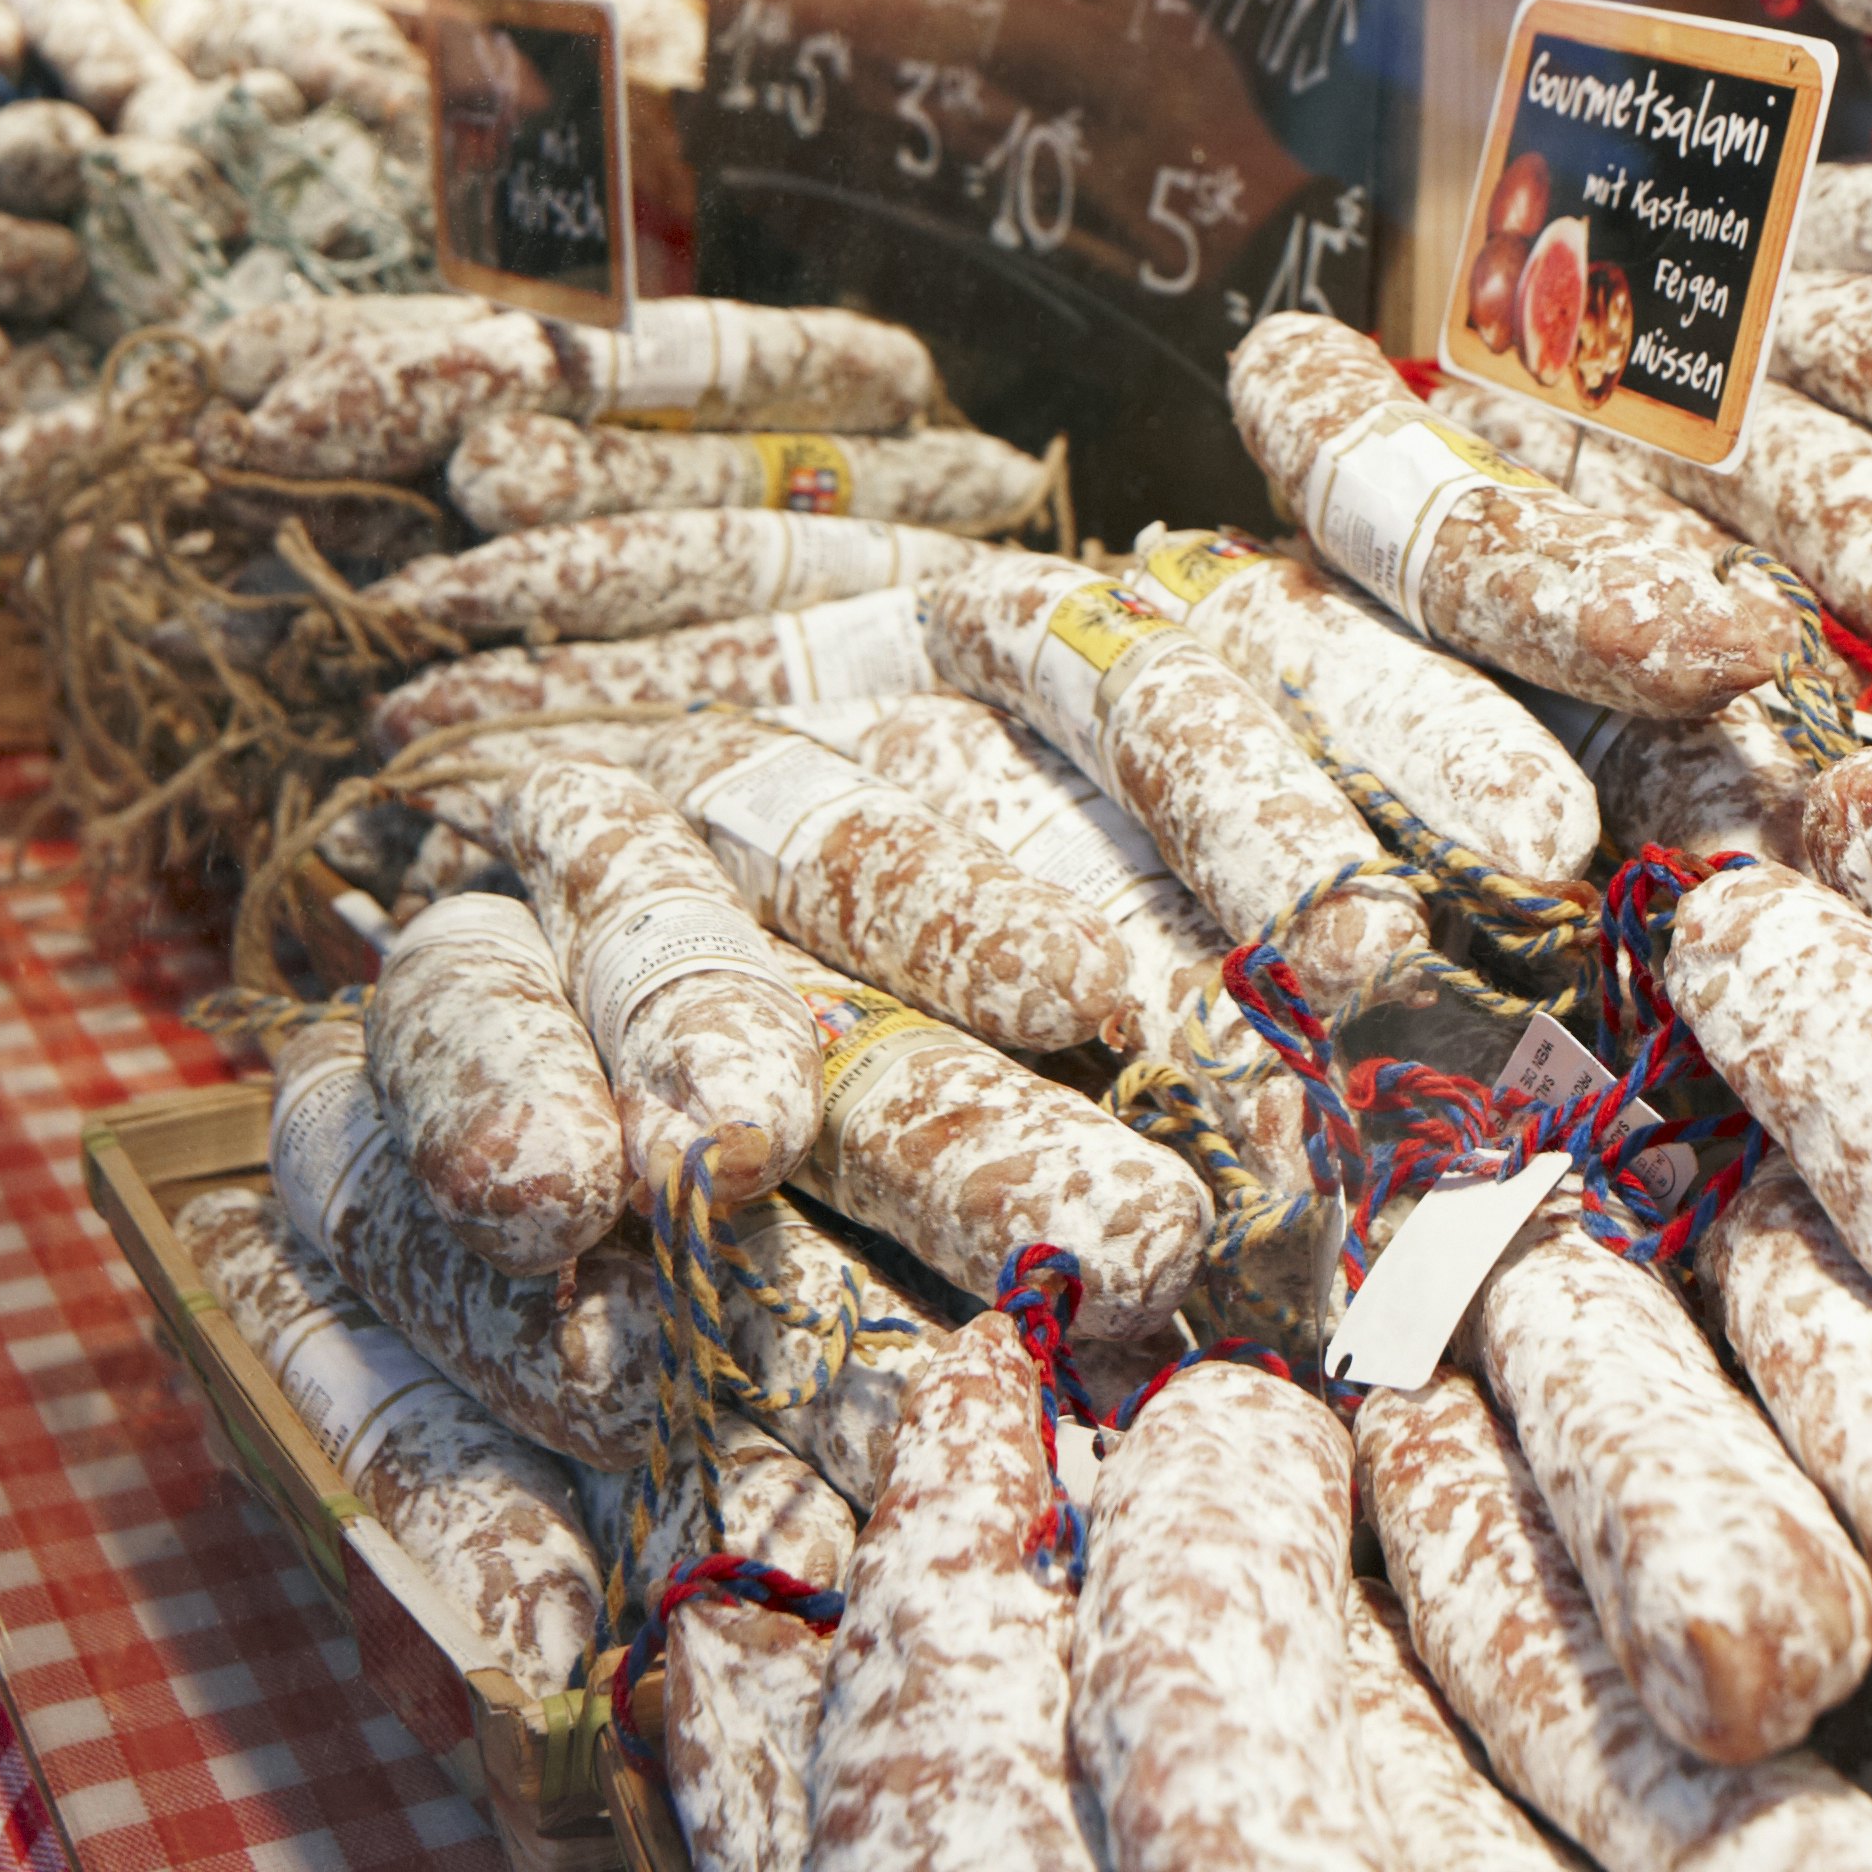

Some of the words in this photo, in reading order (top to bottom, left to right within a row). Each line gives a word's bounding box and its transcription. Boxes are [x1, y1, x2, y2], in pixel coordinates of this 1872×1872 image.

[1527, 50, 1777, 168] Gourmetsalami
[1581, 161, 1629, 212] mit
[1630, 179, 1752, 251] Kastanien
[1653, 257, 1731, 329] Feigen
[1631, 329, 1726, 400] Nüssen
